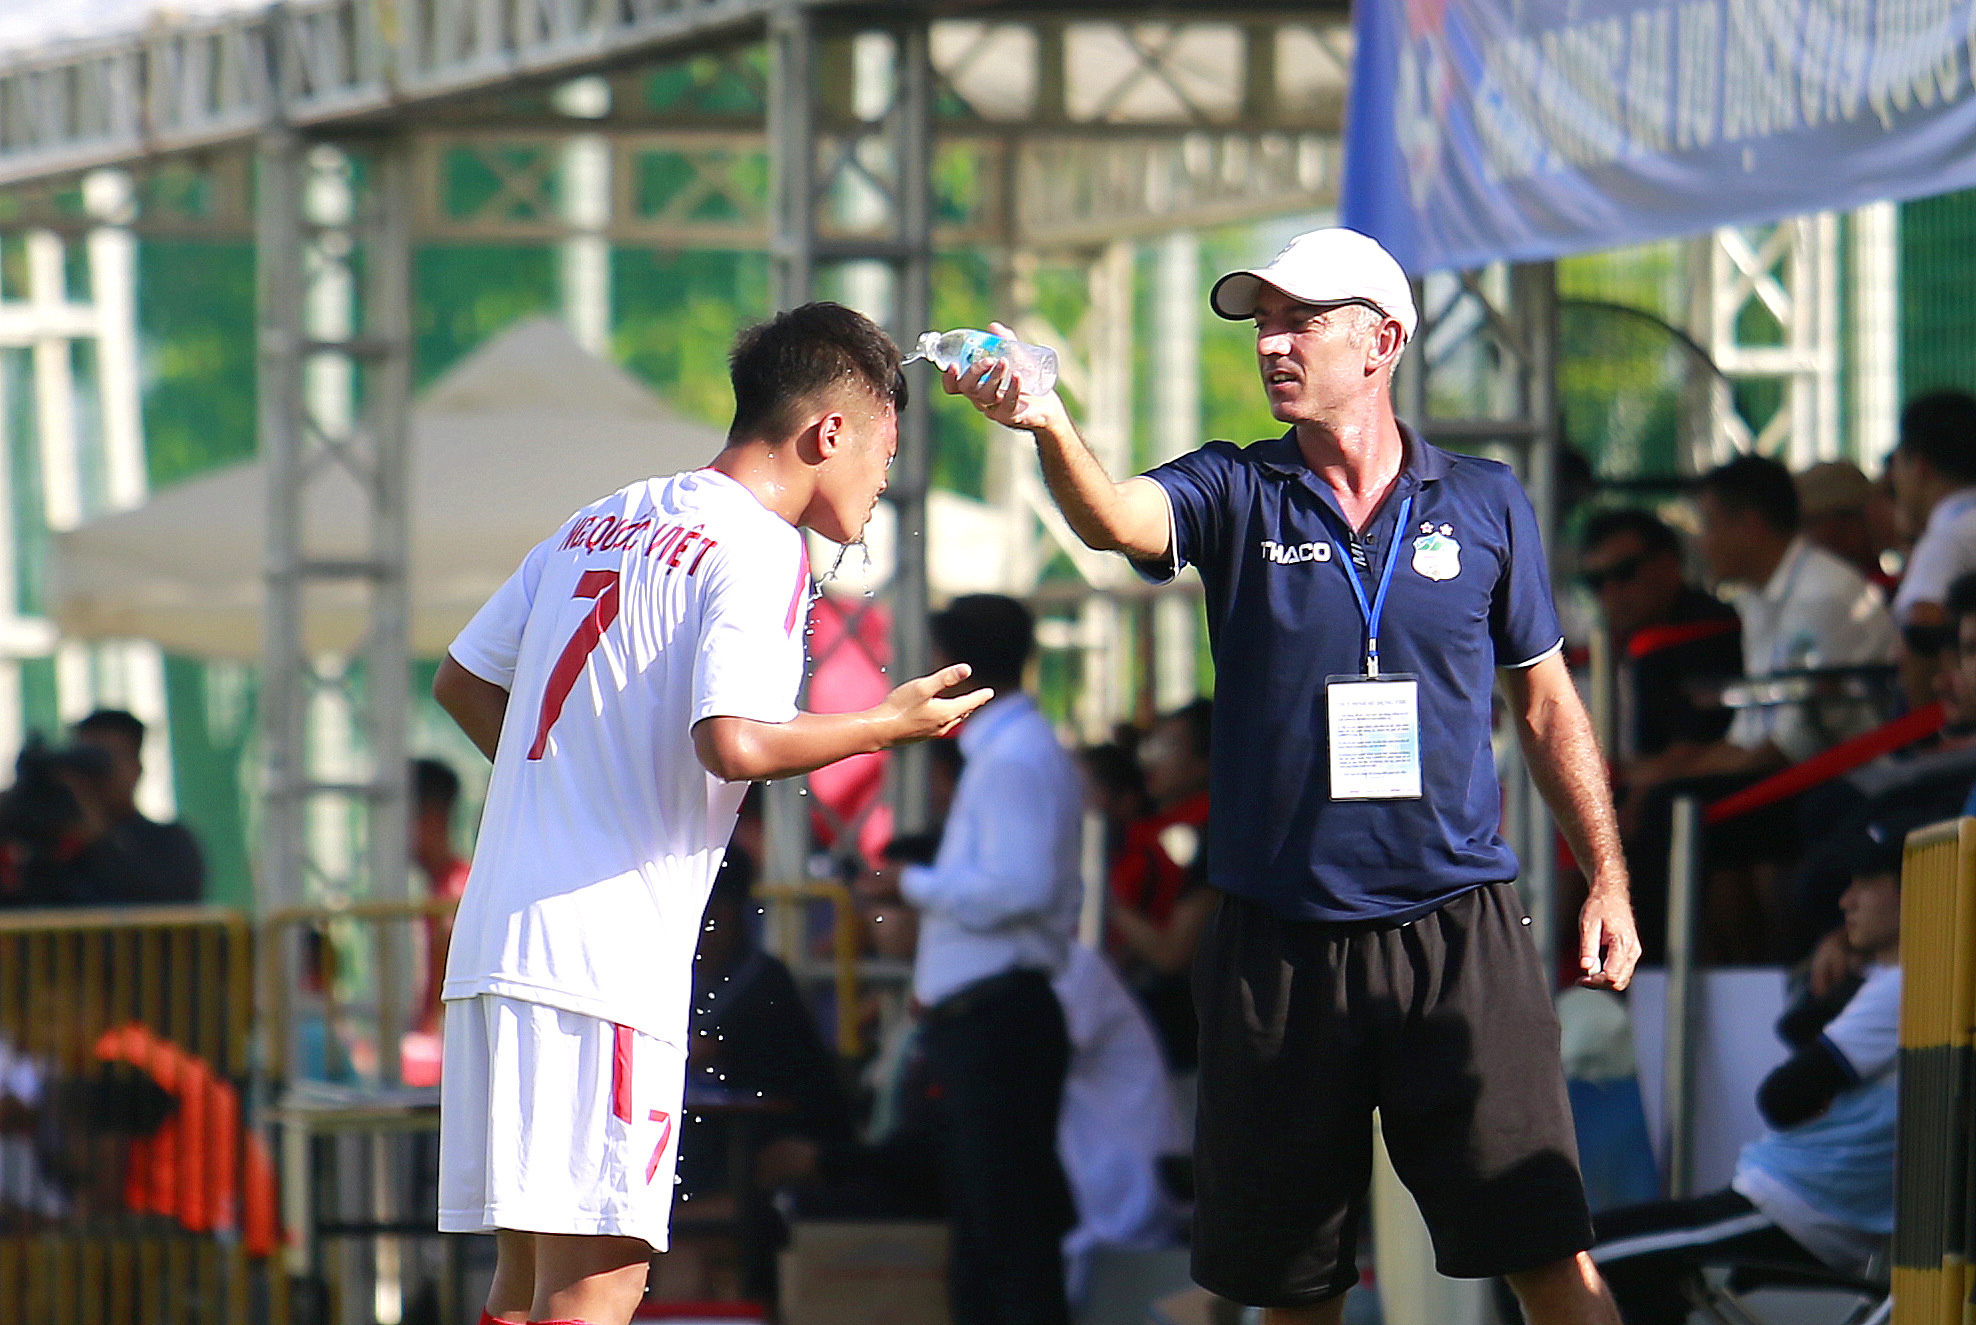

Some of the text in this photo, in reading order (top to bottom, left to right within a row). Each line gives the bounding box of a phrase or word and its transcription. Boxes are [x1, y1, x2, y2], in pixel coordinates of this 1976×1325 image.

[644, 522, 718, 577] VIỆT
[1261, 540, 1331, 564] THACO
[527, 570, 620, 760] 7
[645, 1109, 671, 1186] 7
